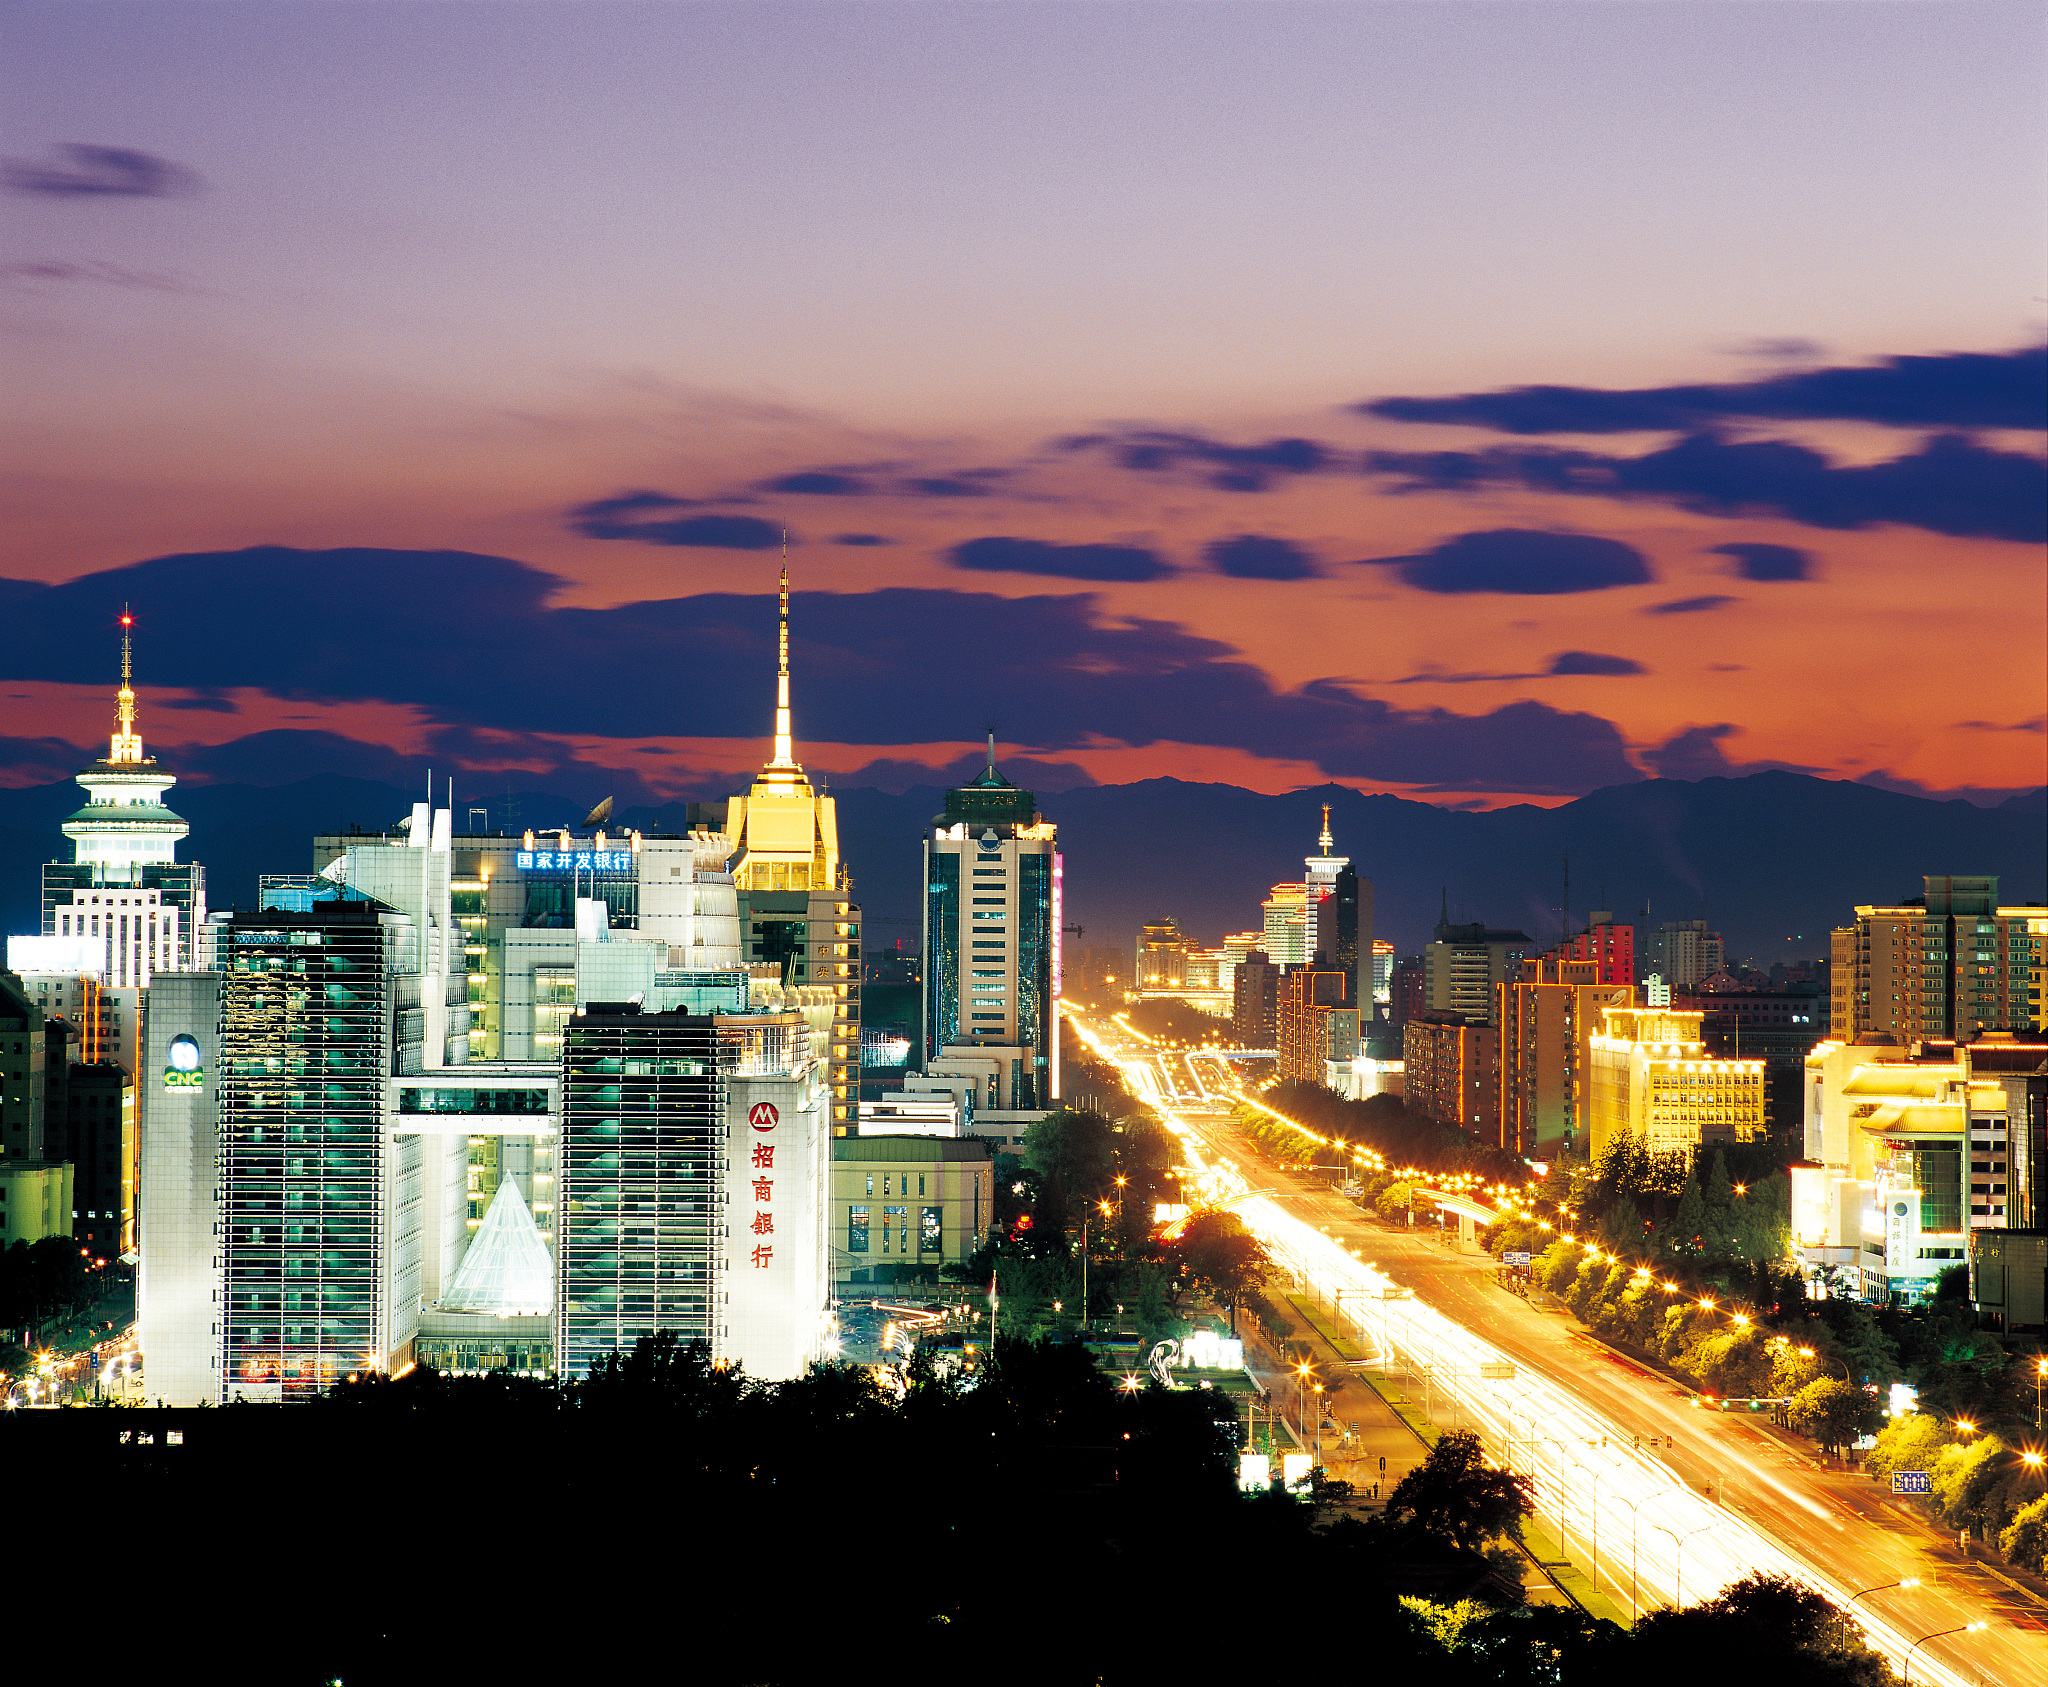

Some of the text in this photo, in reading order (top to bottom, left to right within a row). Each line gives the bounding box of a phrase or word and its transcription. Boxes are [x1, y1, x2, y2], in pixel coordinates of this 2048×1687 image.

[517, 851, 631, 870] 国家开发银行
[817, 944, 831, 978] 中央
[164, 1071, 203, 1086] CNC
[751, 1142, 775, 1269] 招商銀行
